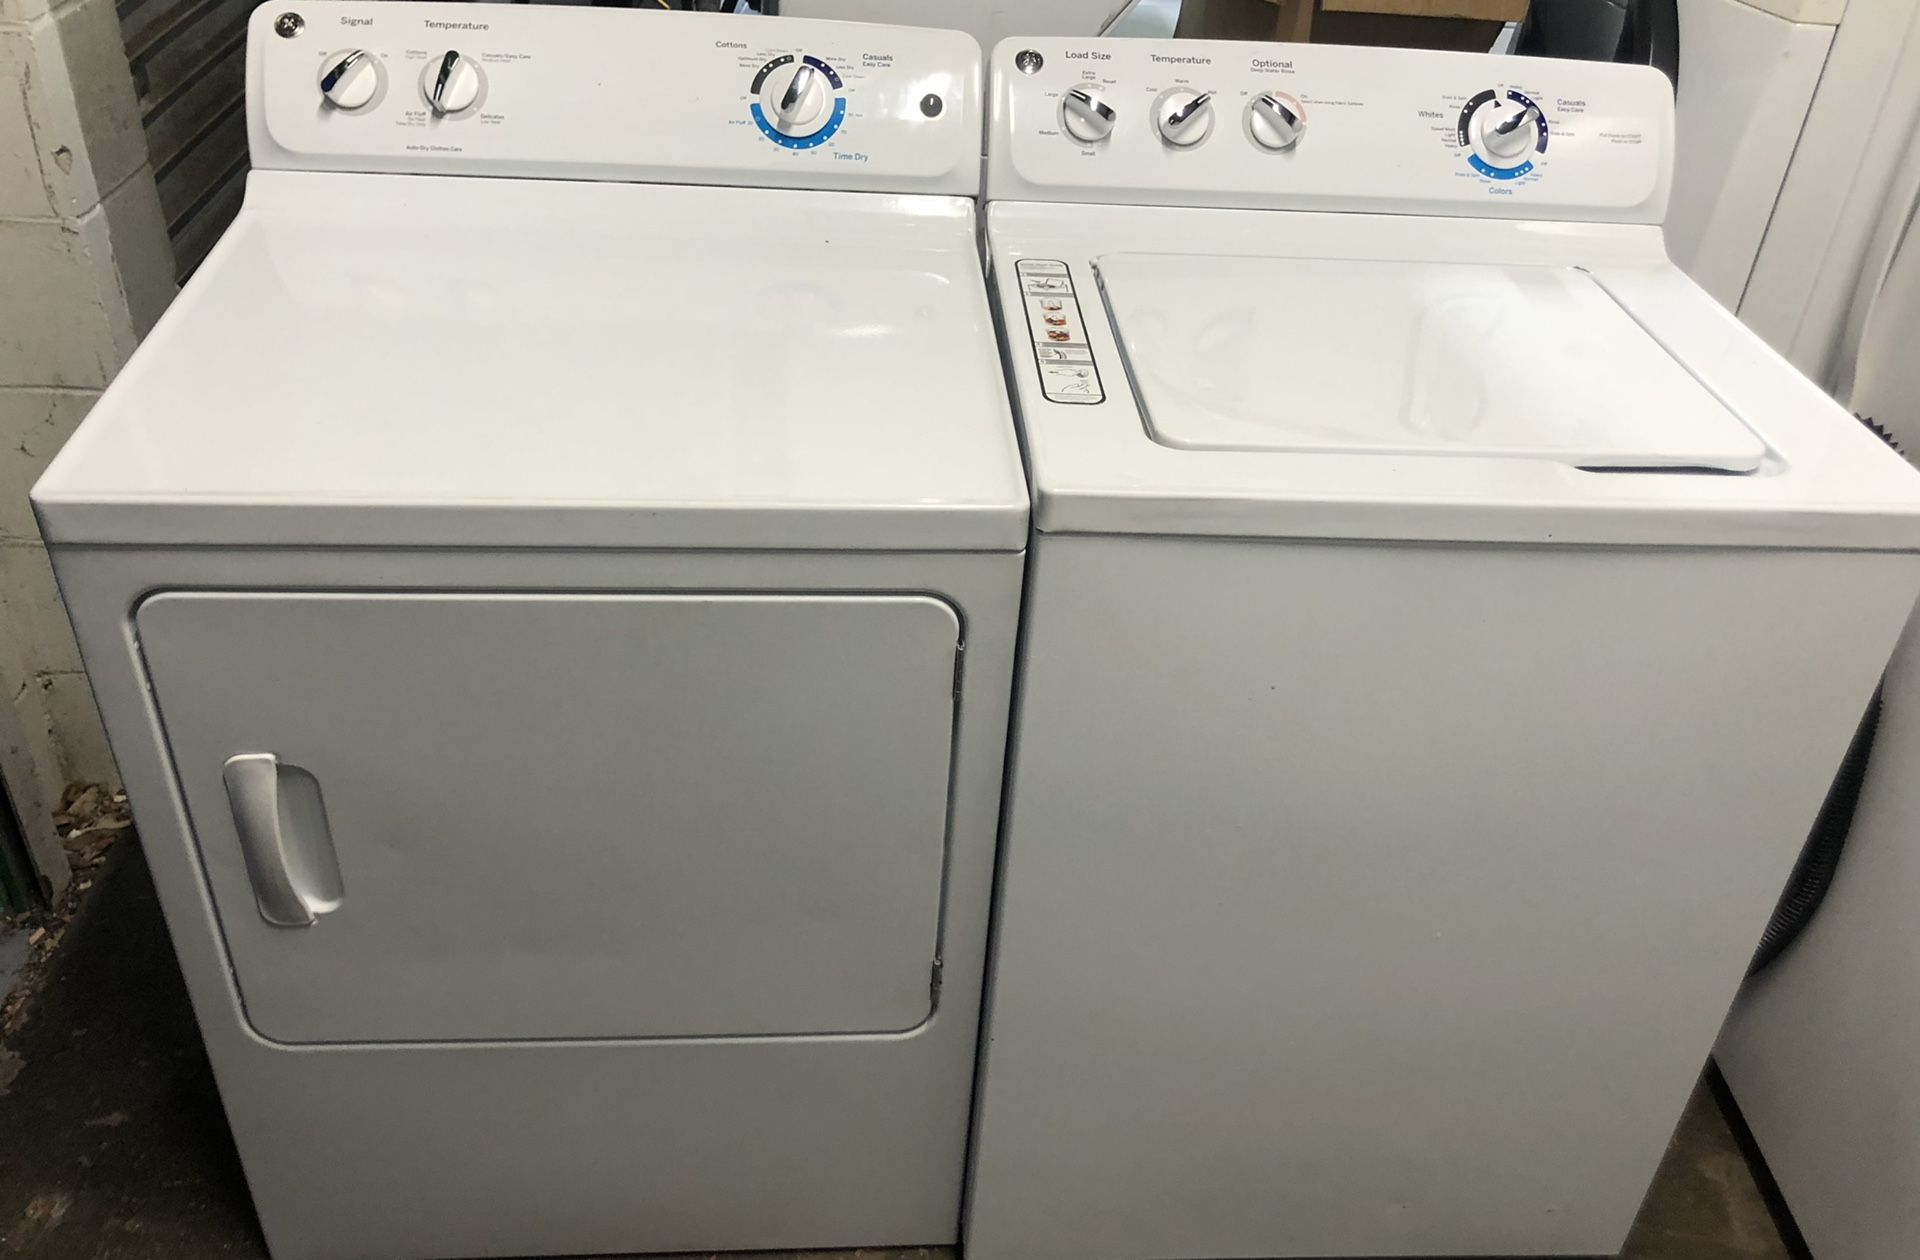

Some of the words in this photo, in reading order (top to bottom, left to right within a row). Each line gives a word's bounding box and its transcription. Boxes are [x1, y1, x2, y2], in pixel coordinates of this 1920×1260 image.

[340, 16, 373, 27] Signal
[424, 19, 490, 31] Temperature
[715, 40, 748, 49] Cottons
[862, 52, 893, 62] Casuals
[1065, 50, 1089, 60] Load
[1091, 51, 1112, 61] Size
[1150, 53, 1212, 65] Temperature
[1252, 58, 1294, 69] Optional
[1557, 98, 1587, 107] Casuals
[1418, 109, 1445, 120] Whites
[833, 151, 853, 161] Time
[854, 152, 869, 162] Dry
[1488, 187, 1513, 196] Colors
